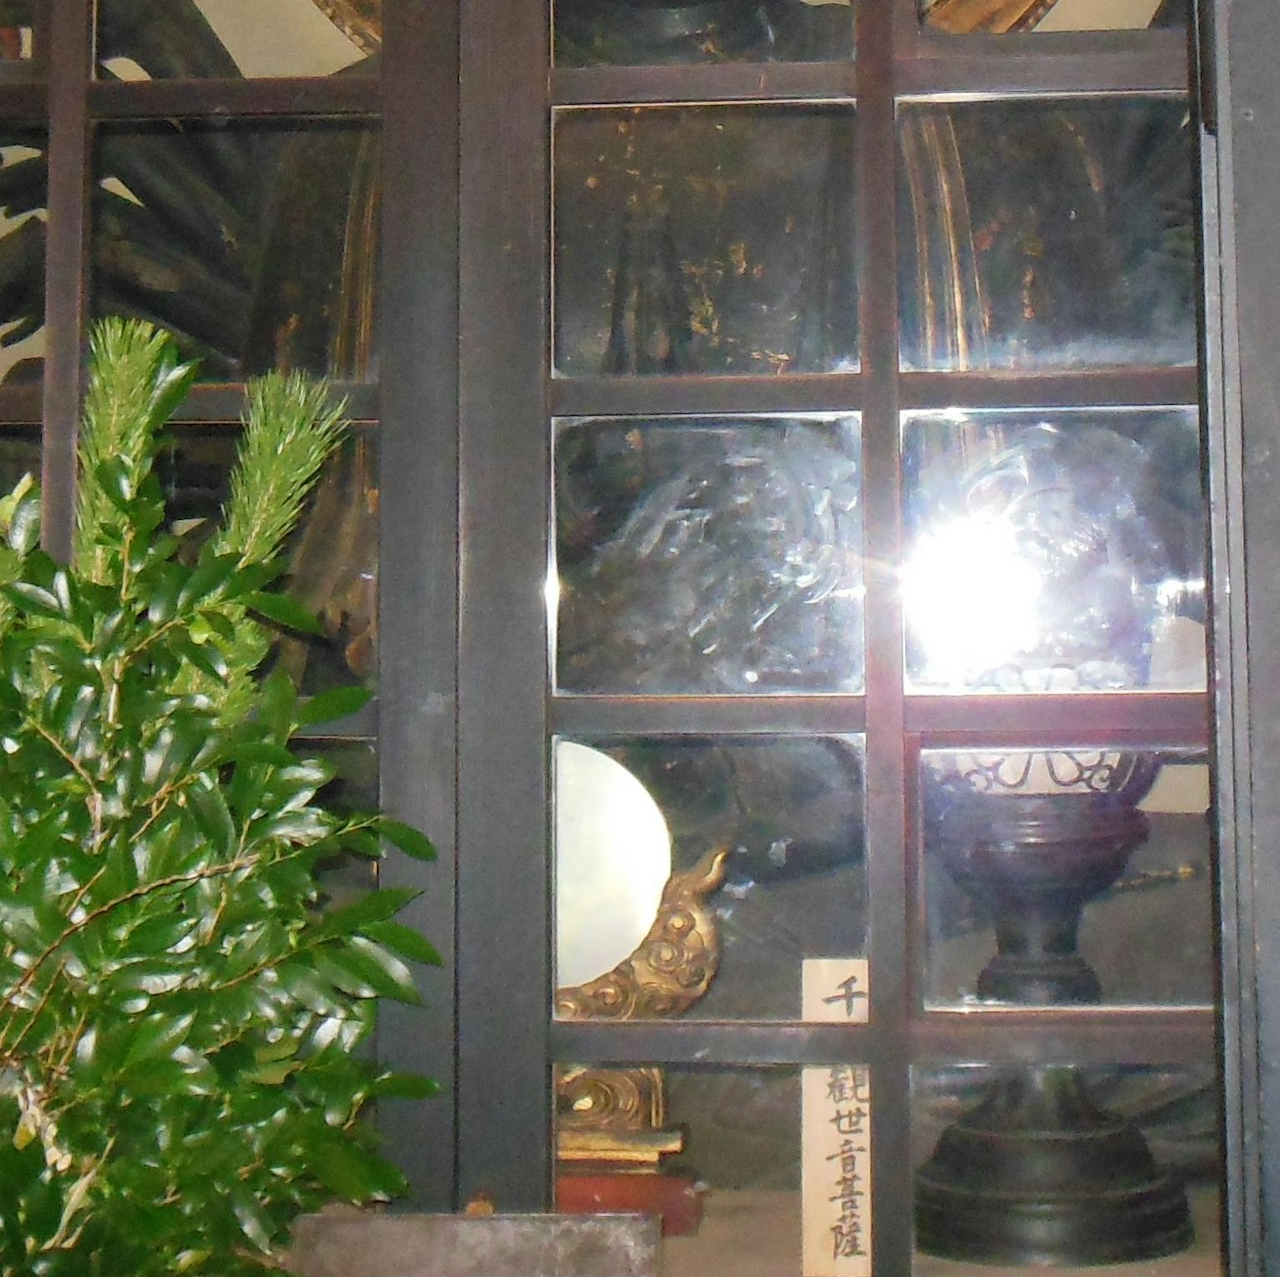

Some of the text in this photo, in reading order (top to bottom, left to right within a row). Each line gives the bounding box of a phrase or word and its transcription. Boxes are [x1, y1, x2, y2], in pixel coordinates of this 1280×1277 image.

[823, 975, 869, 1259] 千観世音菩薩
